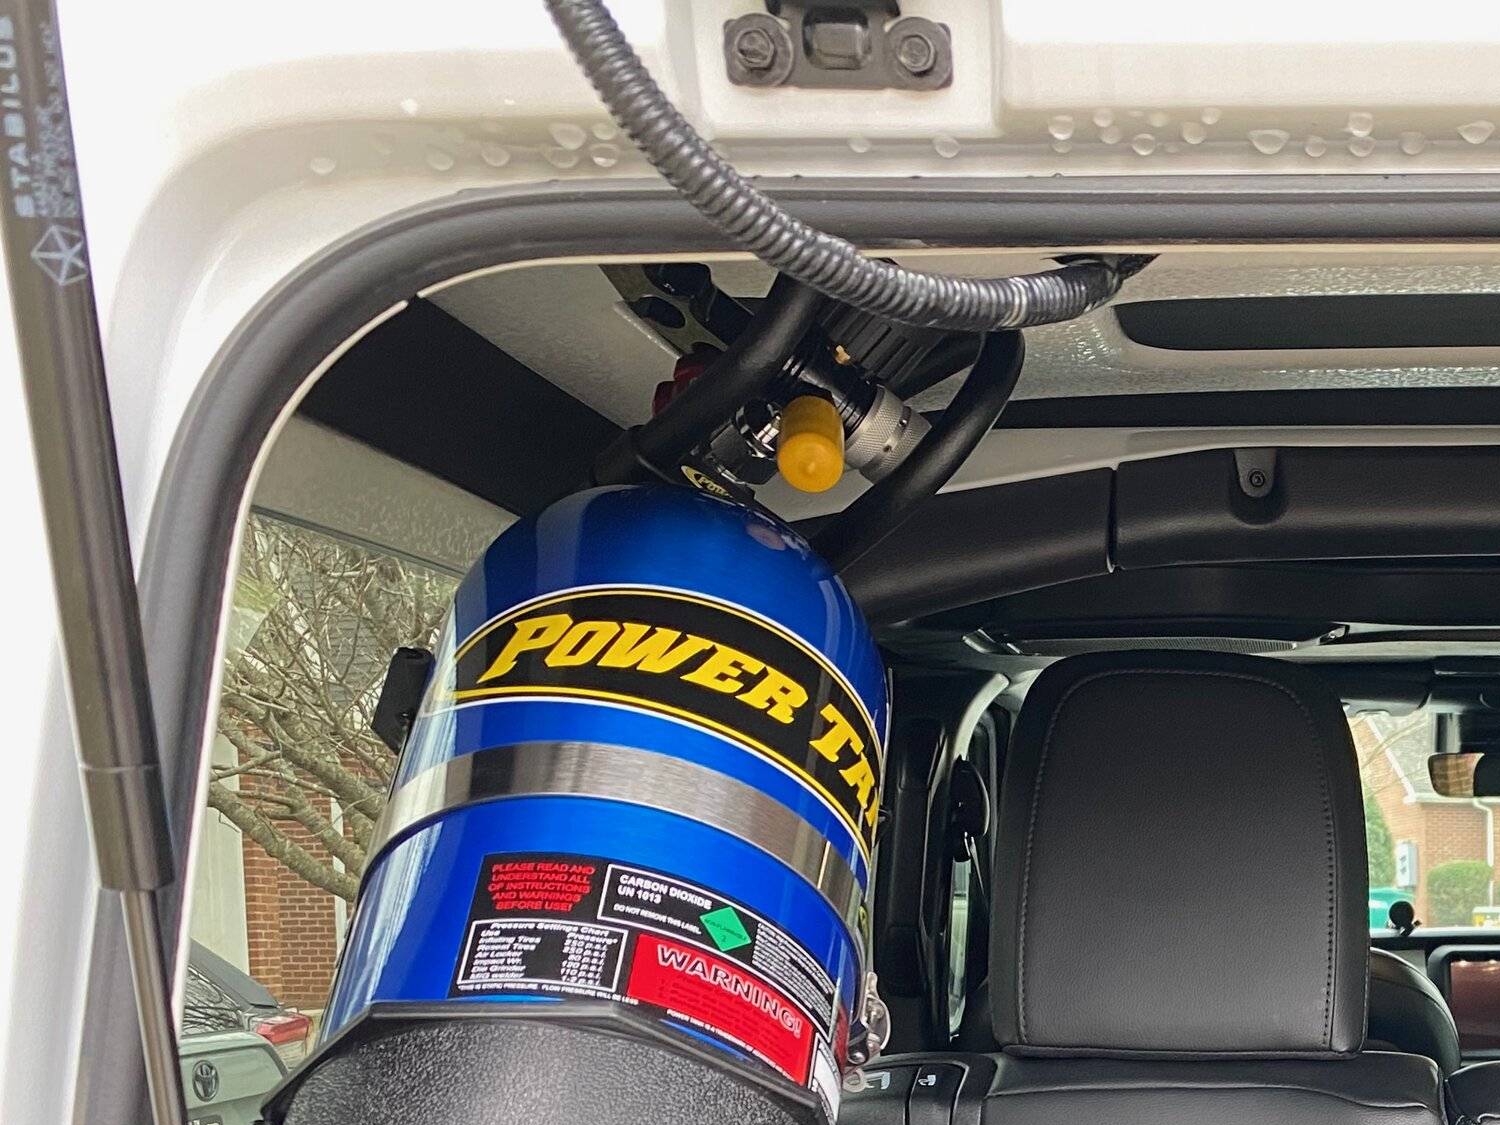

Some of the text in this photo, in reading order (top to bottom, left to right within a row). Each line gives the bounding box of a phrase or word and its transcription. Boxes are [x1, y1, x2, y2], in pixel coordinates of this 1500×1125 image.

[477, 613, 809, 724] POWER
[491, 862, 597, 875] PLEASE READ AND
[491, 872, 590, 884] UNDERSTAND ALL
[505, 882, 591, 894] INSTRUCTIONS
[617, 885, 662, 904] UN 1013
[620, 874, 712, 910] CARBON DIOXIDE
[492, 891, 582, 902] AND WARNINGS
[495, 901, 542, 910] BEFORE
[625, 906, 640, 915] NOT
[640, 909, 667, 923] REMOVE
[490, 922, 536, 930] Pressure
[580, 926, 609, 937] Chart
[657, 943, 803, 1040] WARNING!
